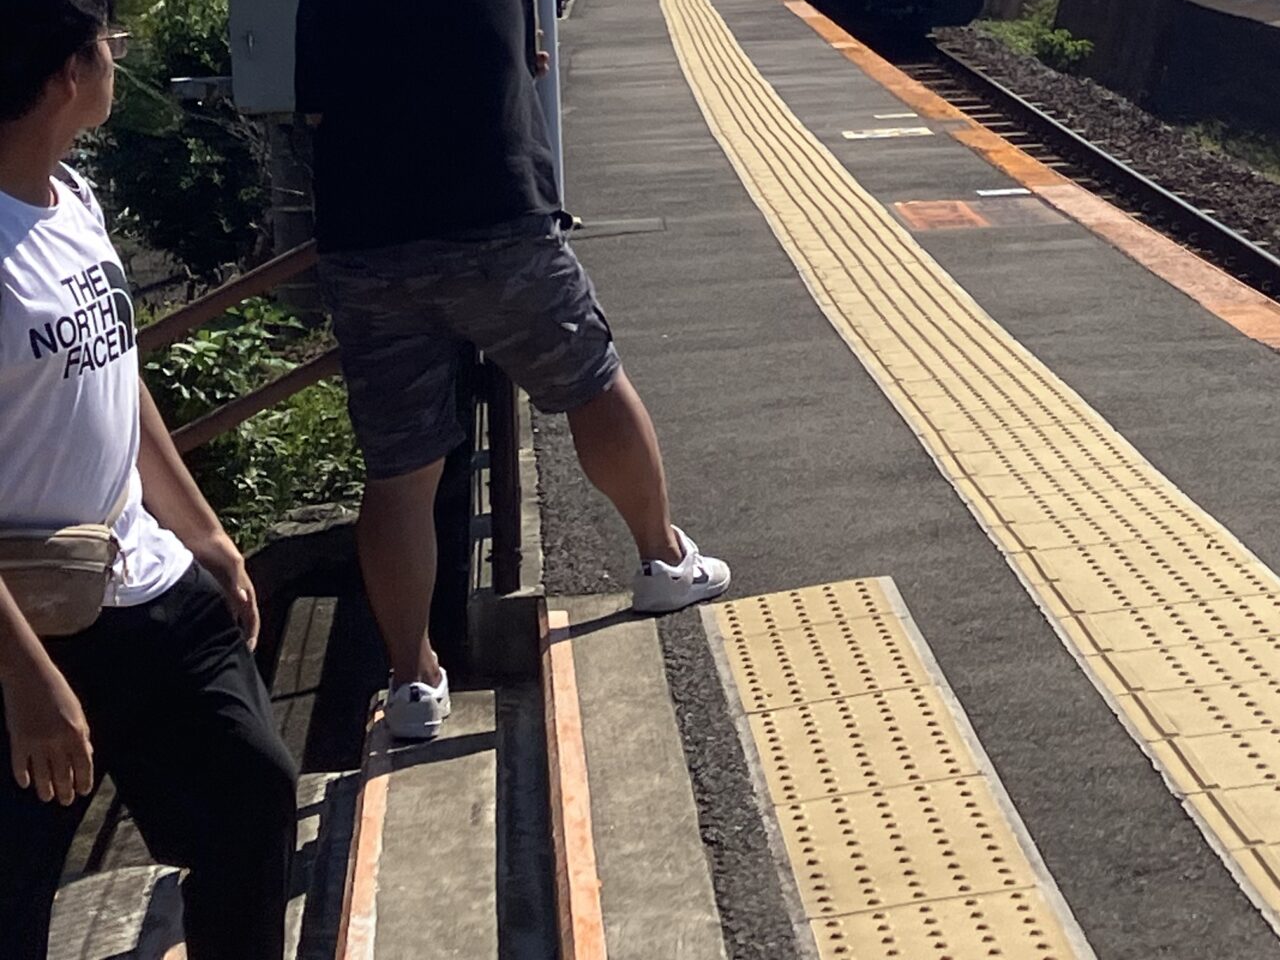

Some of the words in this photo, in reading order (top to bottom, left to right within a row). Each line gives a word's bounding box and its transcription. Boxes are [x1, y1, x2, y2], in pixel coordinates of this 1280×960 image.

[60, 264, 109, 307] THE
[29, 294, 117, 360] NORTH
[63, 327, 120, 380] FACE
